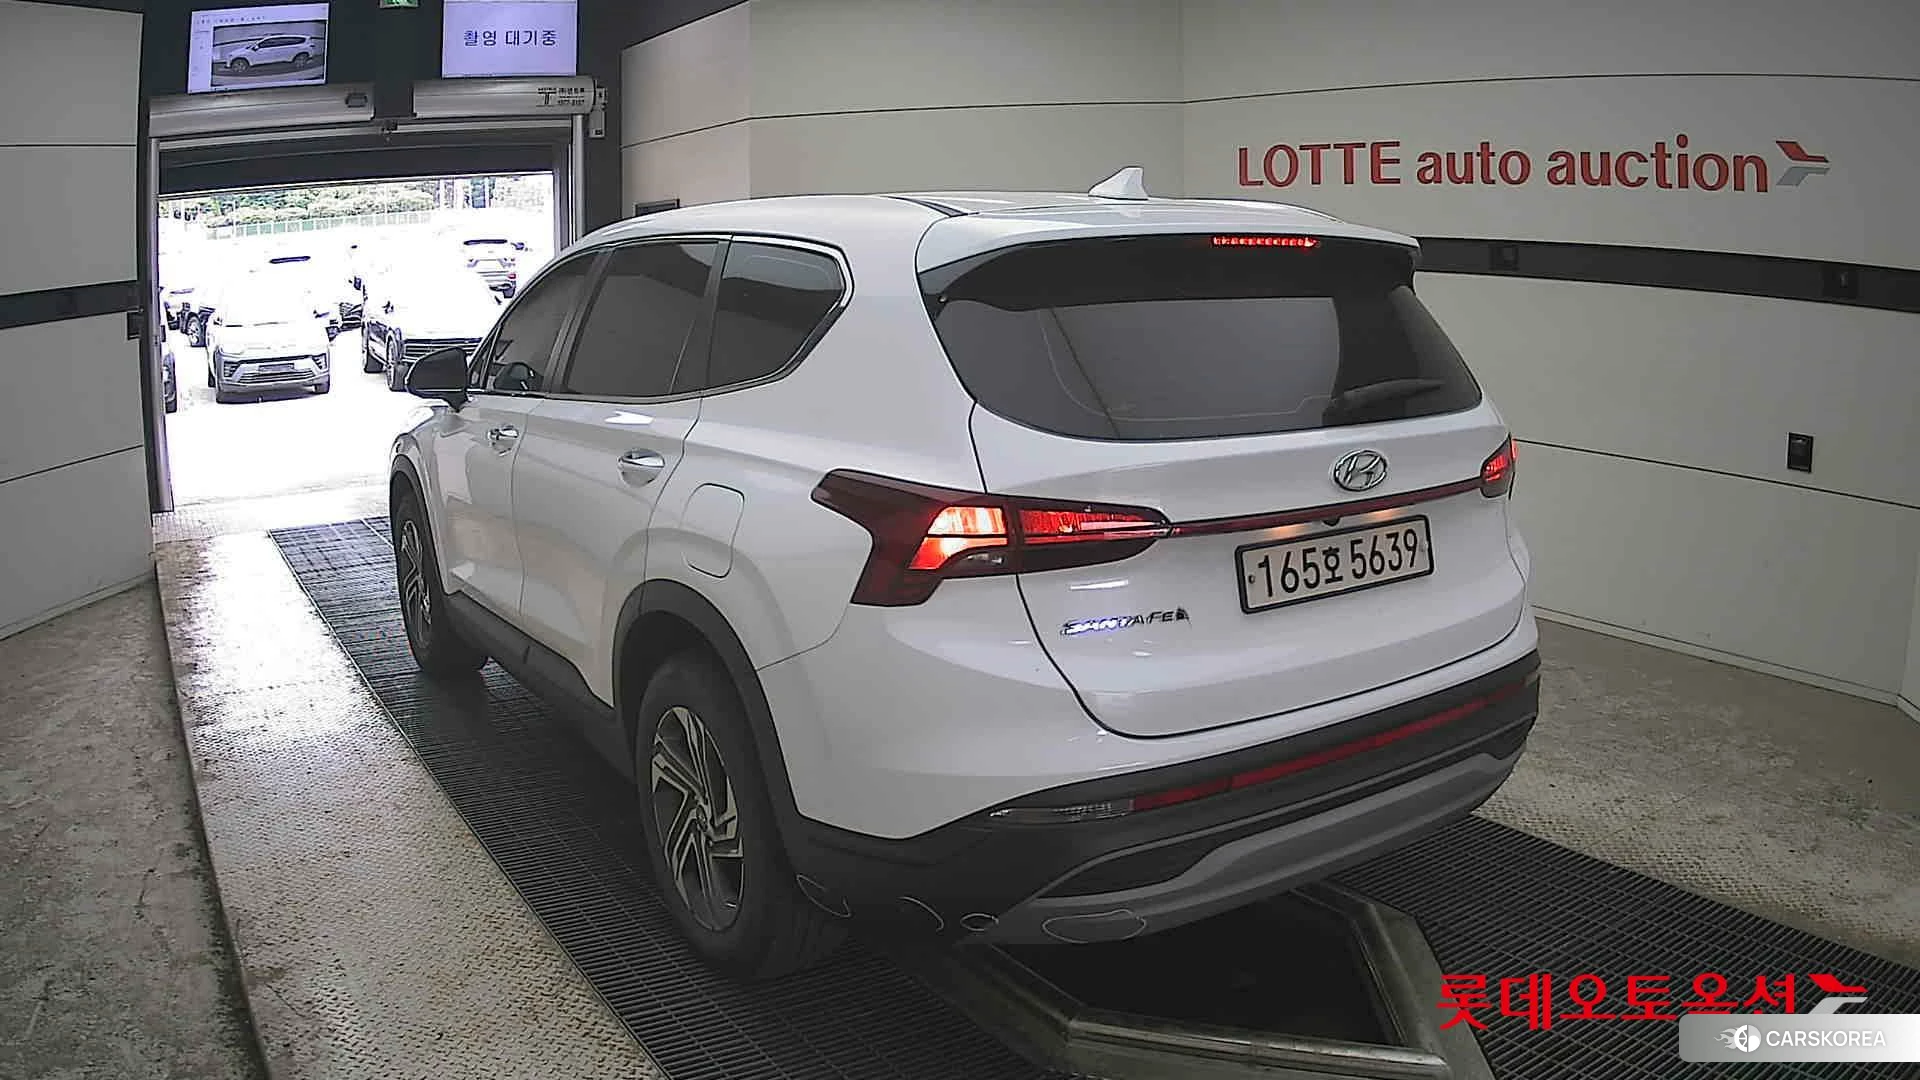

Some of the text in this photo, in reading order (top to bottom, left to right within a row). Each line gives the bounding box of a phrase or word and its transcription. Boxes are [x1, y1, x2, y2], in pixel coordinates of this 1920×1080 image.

[505, 29, 558, 46] 대기중
[1238, 134, 1768, 192] LOTTE auto auction
[1258, 528, 1418, 598] 165호 5639
